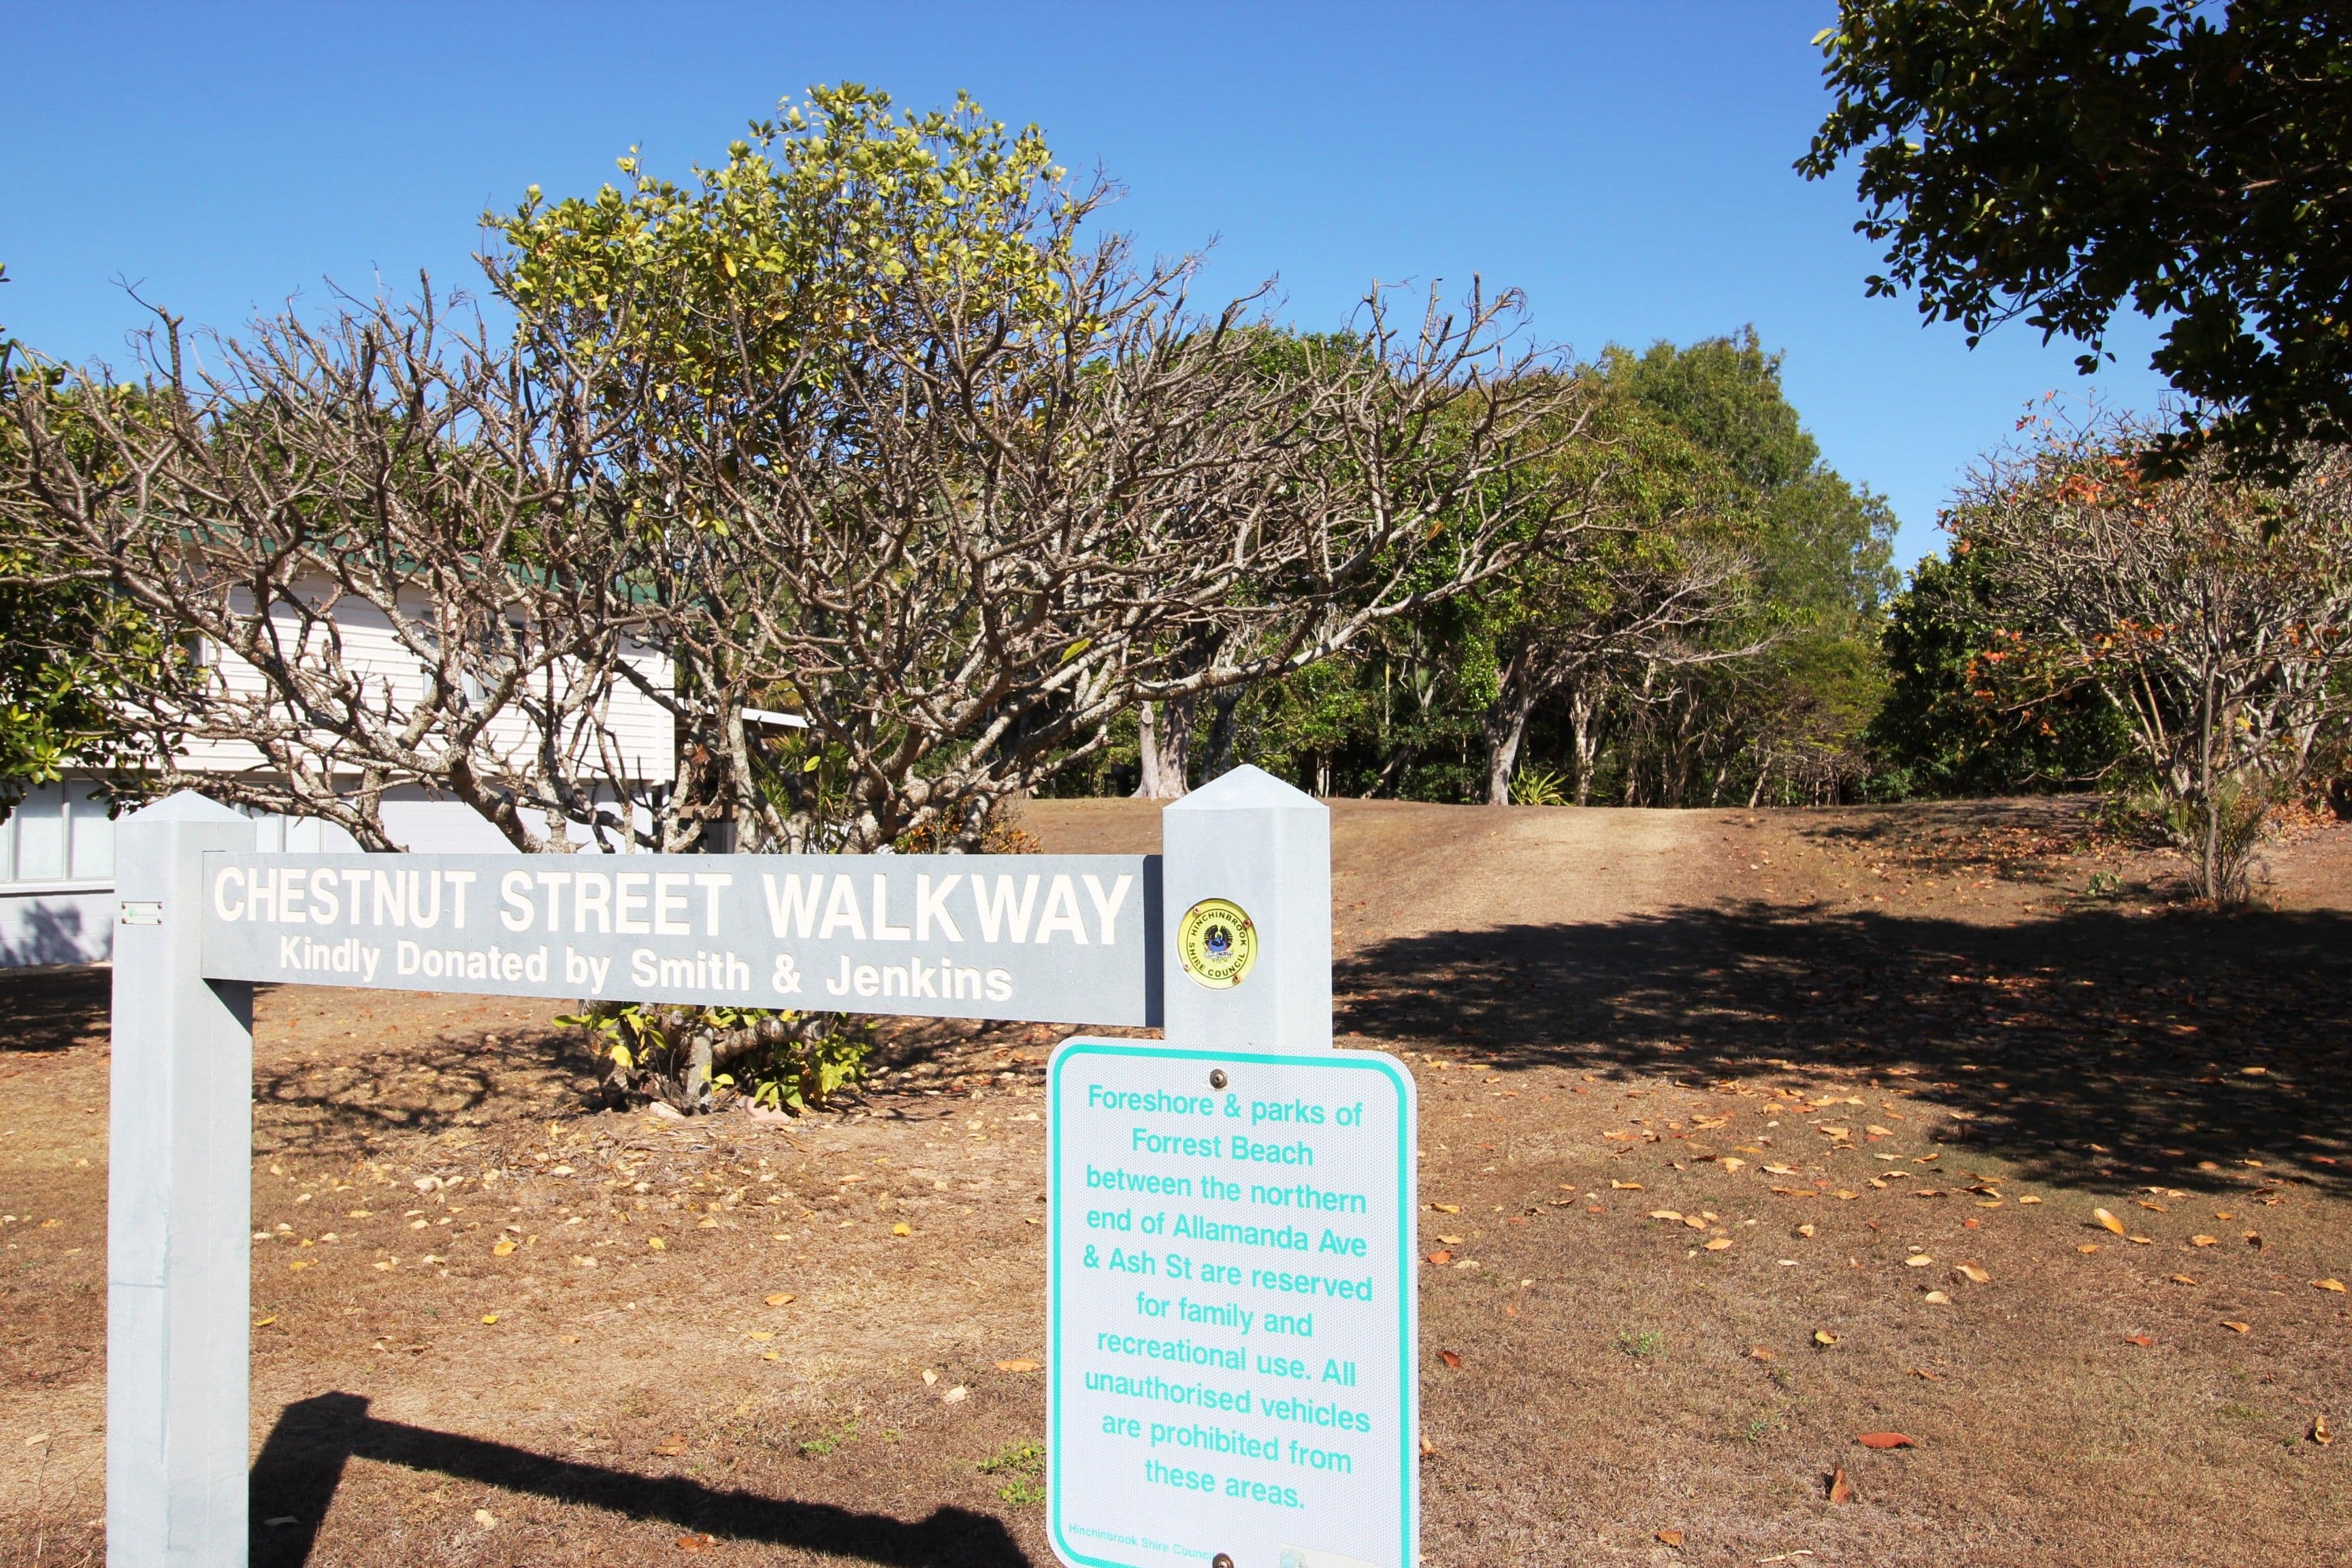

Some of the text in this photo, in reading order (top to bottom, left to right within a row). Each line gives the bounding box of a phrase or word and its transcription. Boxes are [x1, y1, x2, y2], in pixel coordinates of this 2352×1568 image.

[214, 866, 1134, 945] CHESTNUT STREET WALKWAY
[1191, 912, 1246, 946] HINCHINBROOK
[280, 936, 1013, 1002] Kindly Donated by Smith & Jenkins
[1189, 942, 1245, 977] SHIRE COUNCIL
[1088, 1083, 1363, 1127] Foreshore & parks of
[1132, 1127, 1313, 1166] Forrest Beach
[1086, 1164, 1367, 1214] between the northern
[1086, 1209, 1368, 1258] end of Allamanda Ave
[1083, 1244, 1373, 1302] & Ash St are reserved
[1137, 1291, 1313, 1337] for family and
[1098, 1333, 1356, 1387] recreational use. All
[1085, 1372, 1371, 1433] unauthorised vehicles
[1102, 1415, 1352, 1473] are prohibited from
[1145, 1459, 1306, 1510] these areas.
[1068, 1524, 1138, 1546] Hinchinbrook
